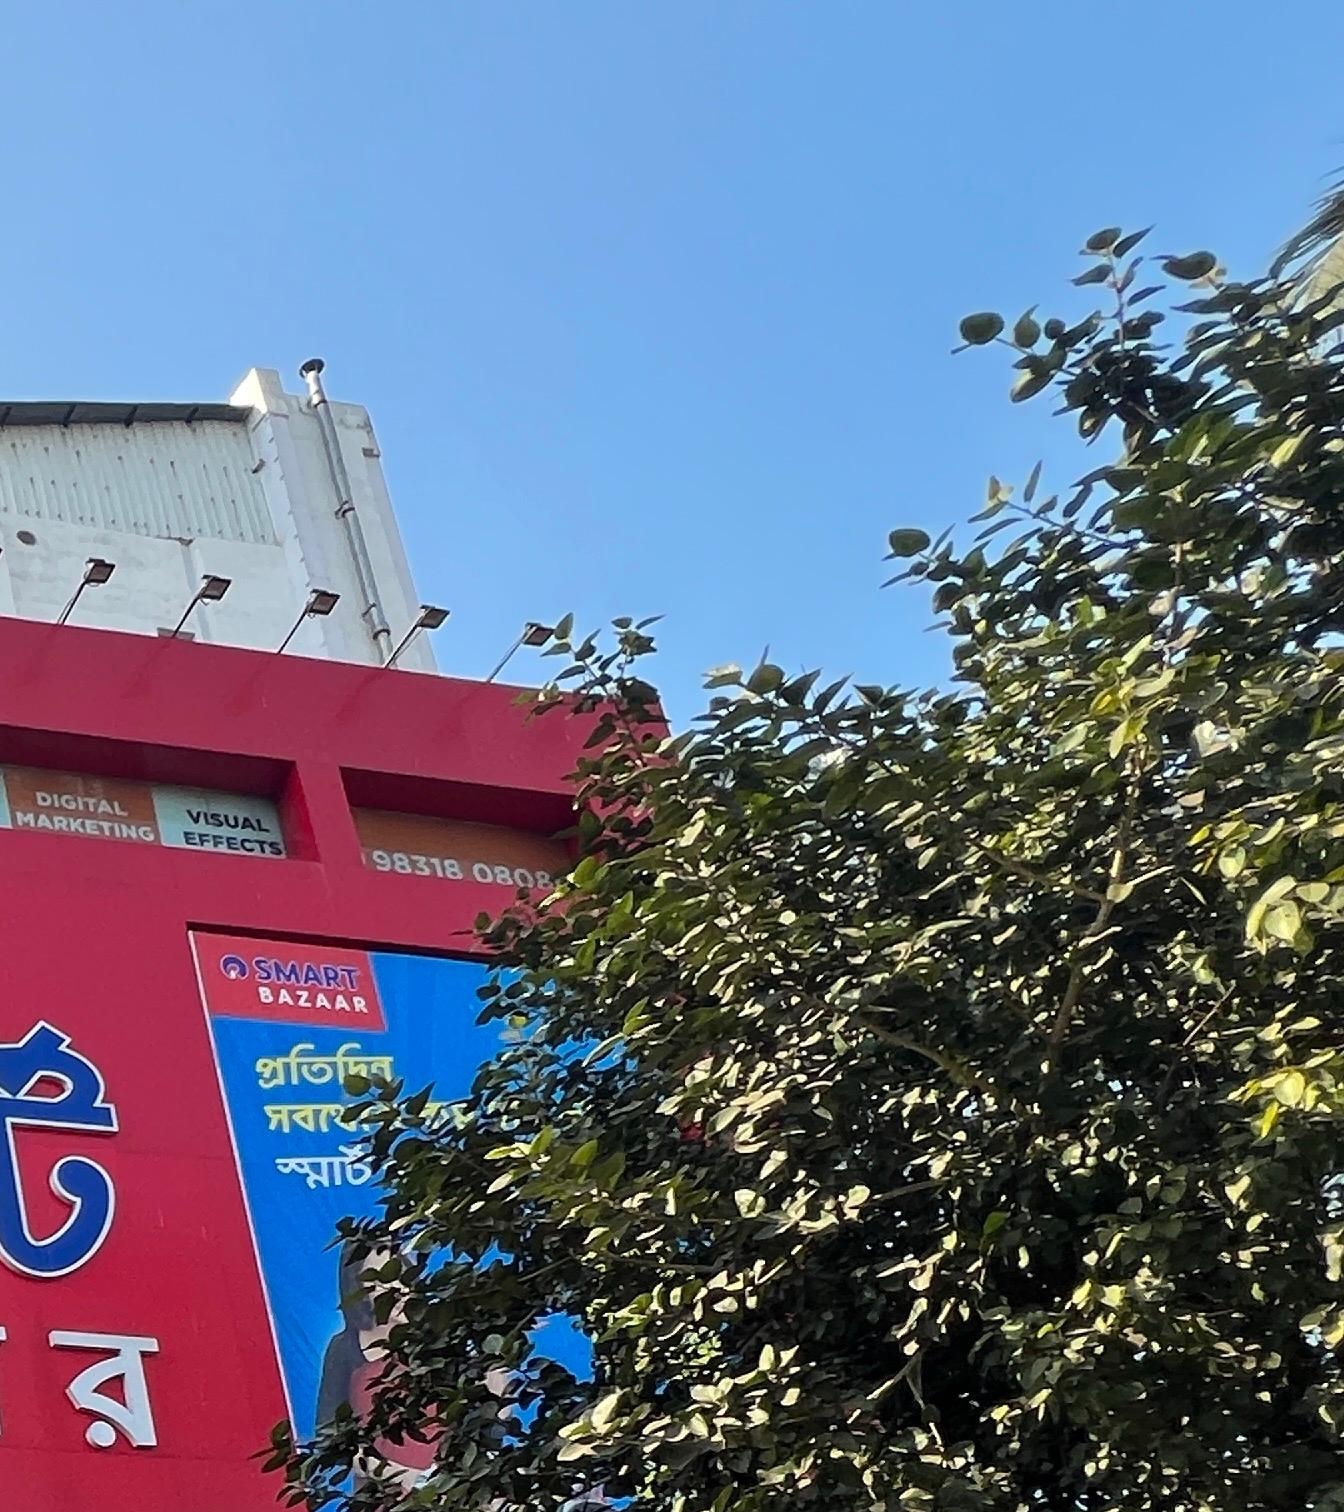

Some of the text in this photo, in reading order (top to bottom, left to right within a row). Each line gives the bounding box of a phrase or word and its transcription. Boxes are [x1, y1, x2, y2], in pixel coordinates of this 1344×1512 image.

[35, 791, 129, 818] DIGITAL
[15, 811, 156, 843] MARKETING
[186, 809, 271, 834] VISUAL
[183, 831, 283, 857] EFFECTS
[372, 850, 554, 890] 98318 0808
[254, 956, 360, 990] SMART
[257, 986, 368, 1014] BAZAAR
